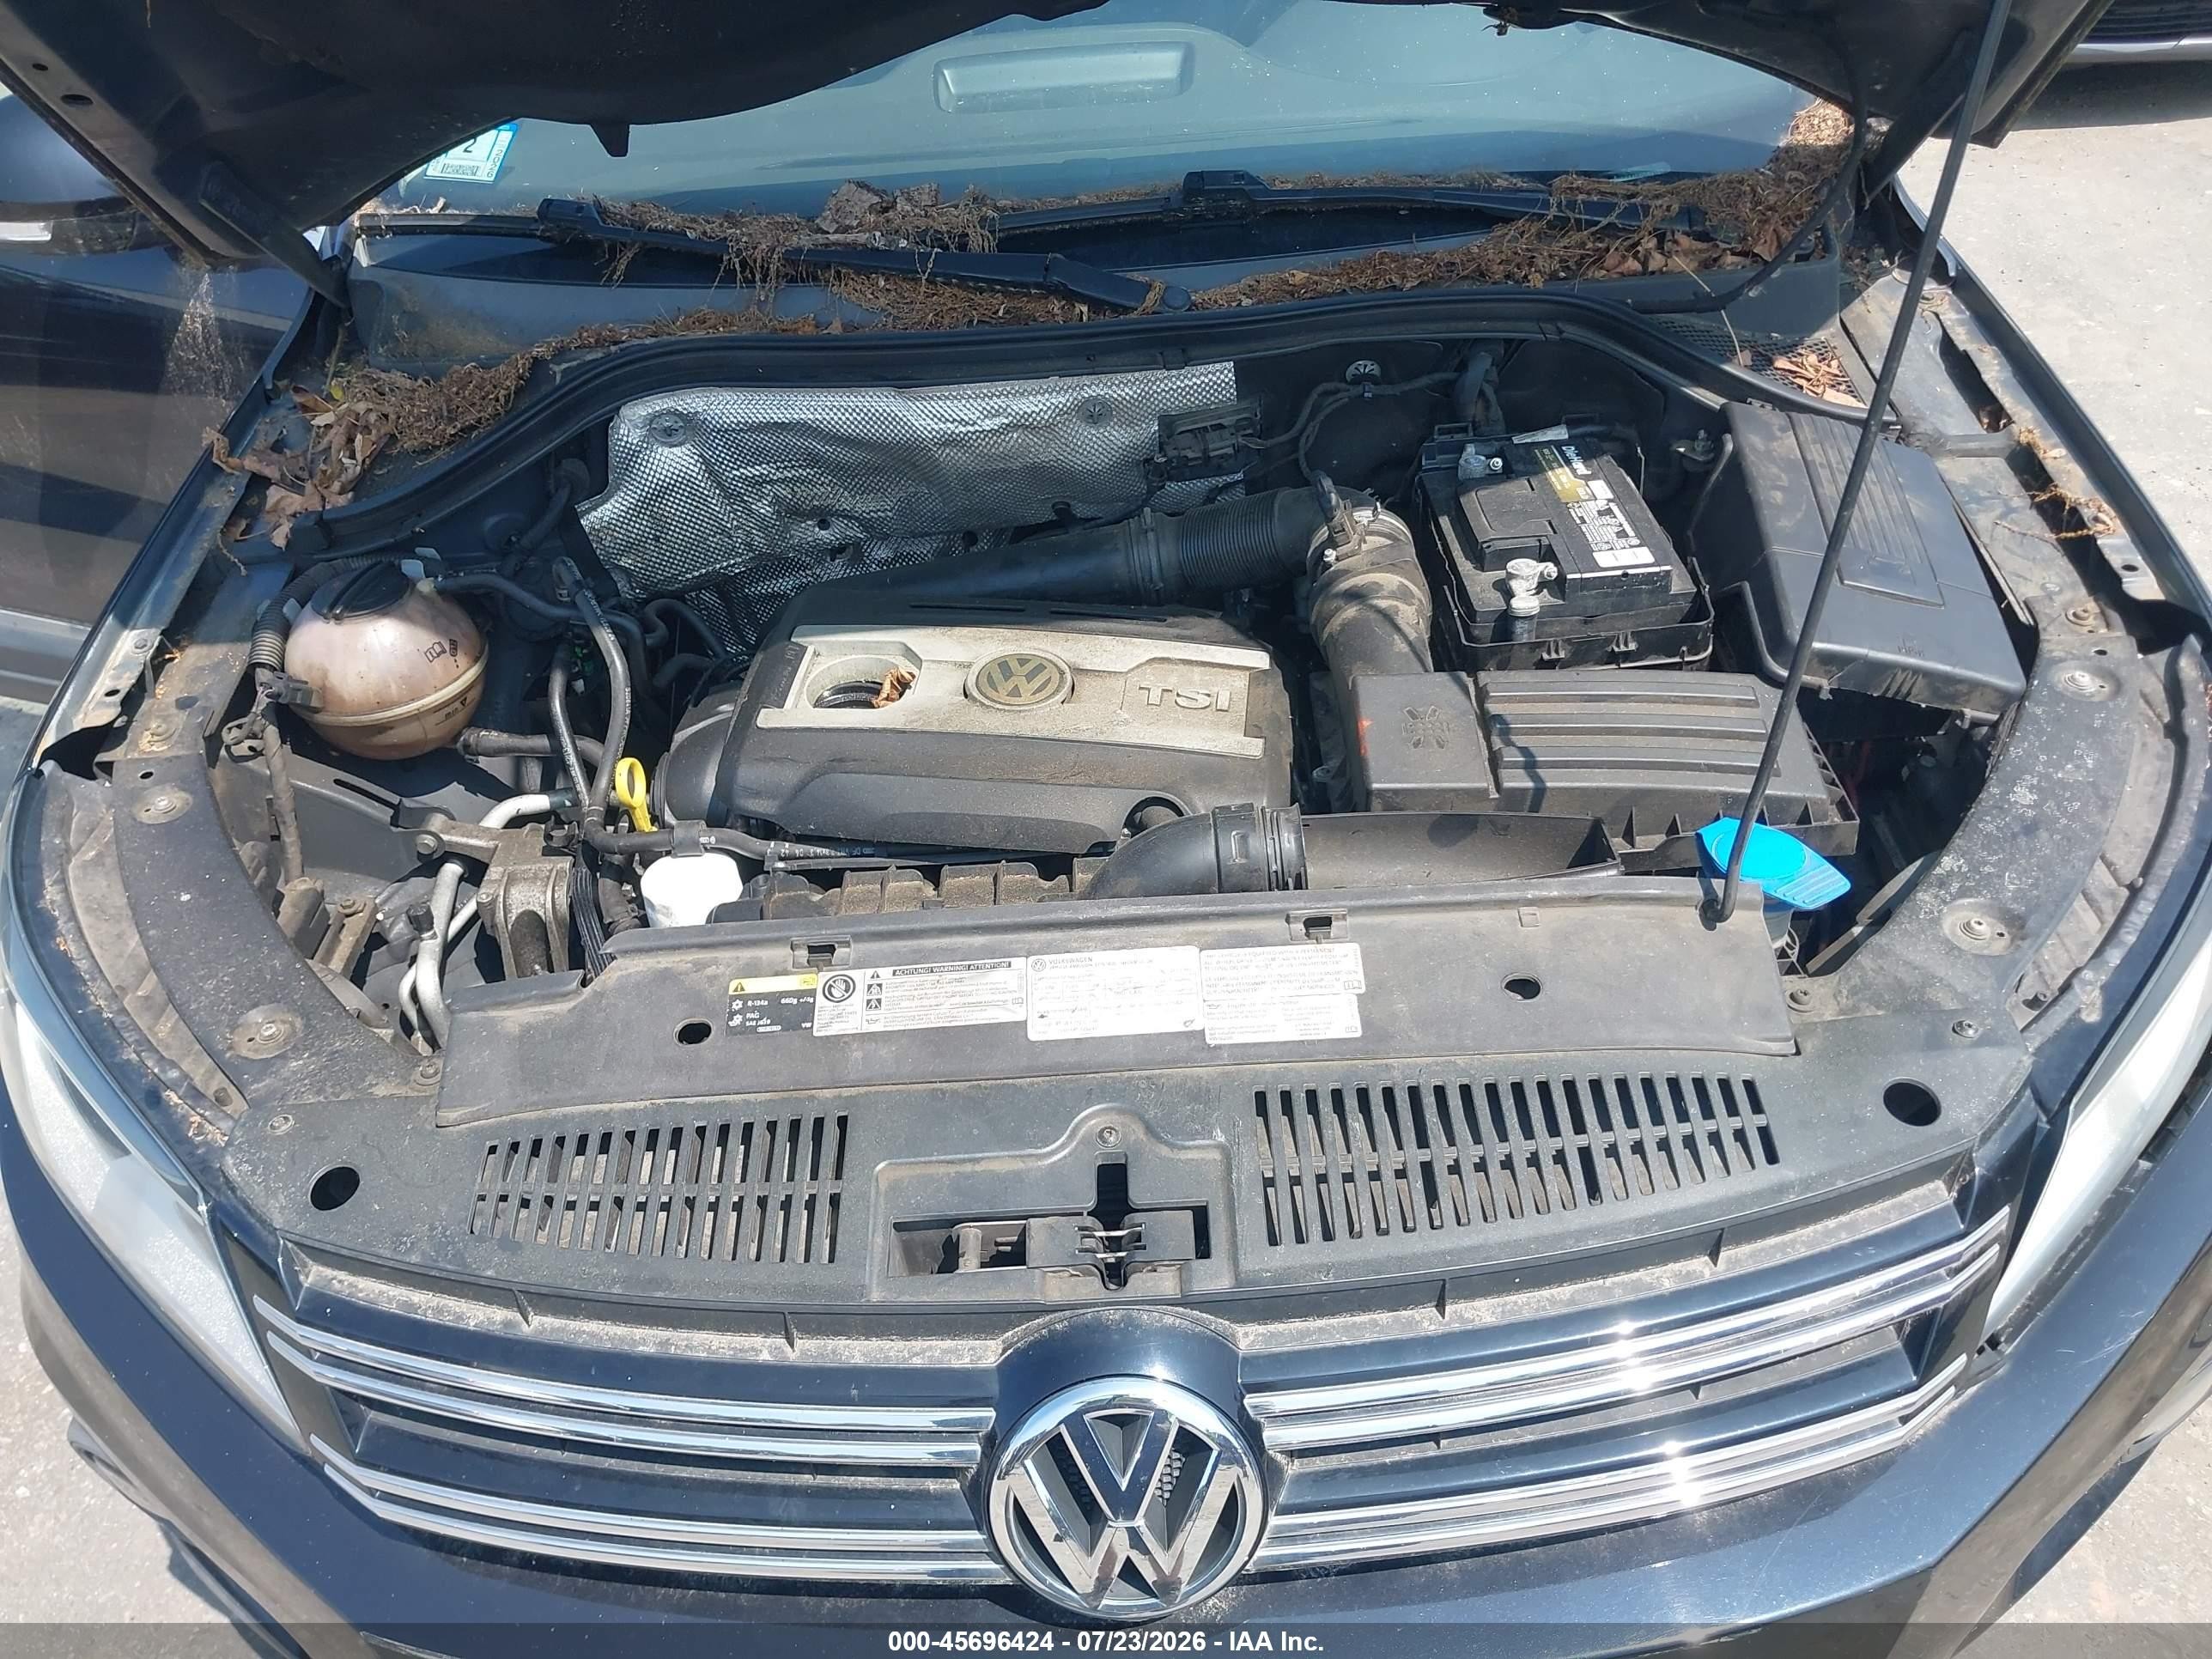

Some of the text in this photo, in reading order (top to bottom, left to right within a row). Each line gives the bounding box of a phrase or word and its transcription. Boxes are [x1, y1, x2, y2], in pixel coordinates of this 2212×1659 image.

[487, 149, 503, 178] 2026
[1561, 446, 1592, 475] DieHard
[1138, 683, 1231, 712] TSI
[894, 961, 1011, 976] ACHTUNG! WARNING! ATTENTION!
[1048, 956, 1093, 965] VOLKSWAGEN
